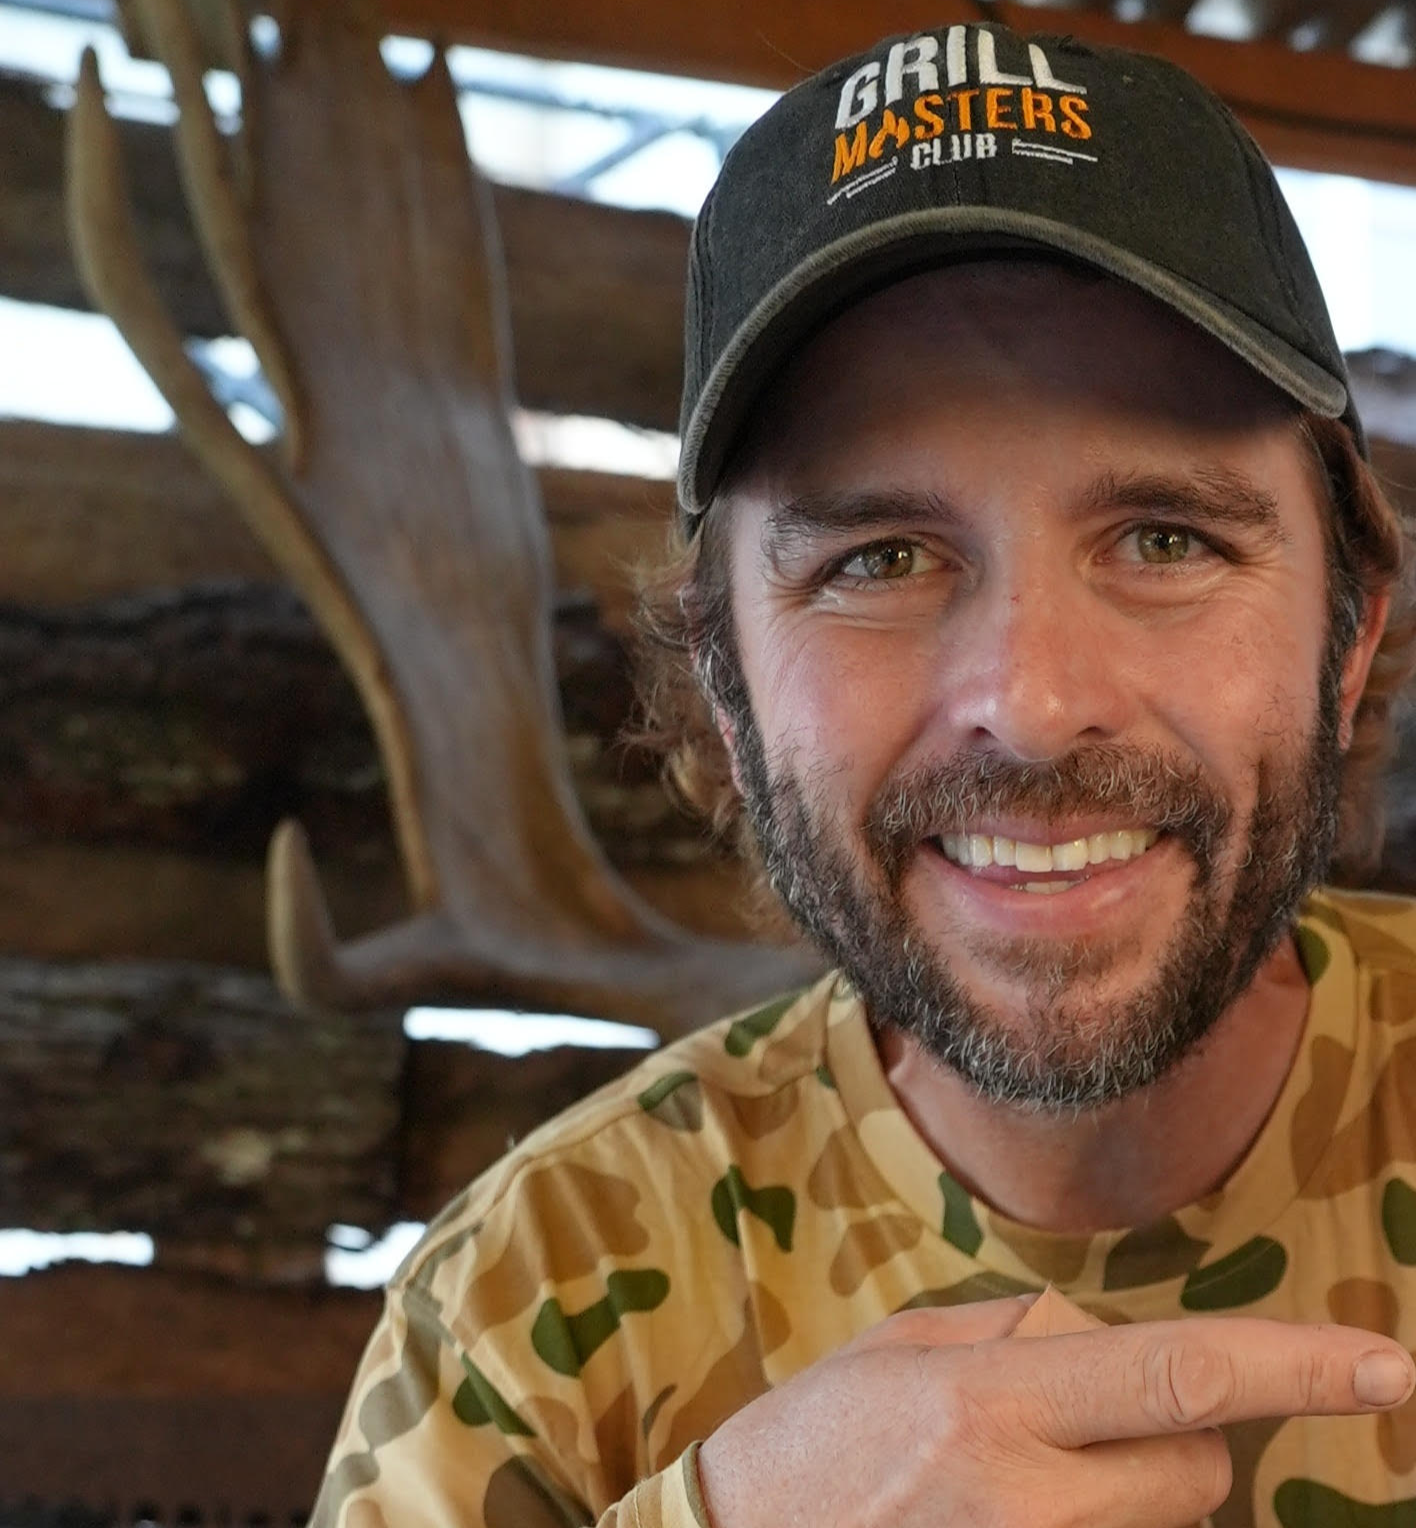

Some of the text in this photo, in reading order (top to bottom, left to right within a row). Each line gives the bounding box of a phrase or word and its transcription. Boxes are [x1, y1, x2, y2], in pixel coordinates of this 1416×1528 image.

[834, 25, 1087, 129] GRILL
[831, 87, 1092, 185] MASTERS
[910, 133, 997, 171] CLUB
